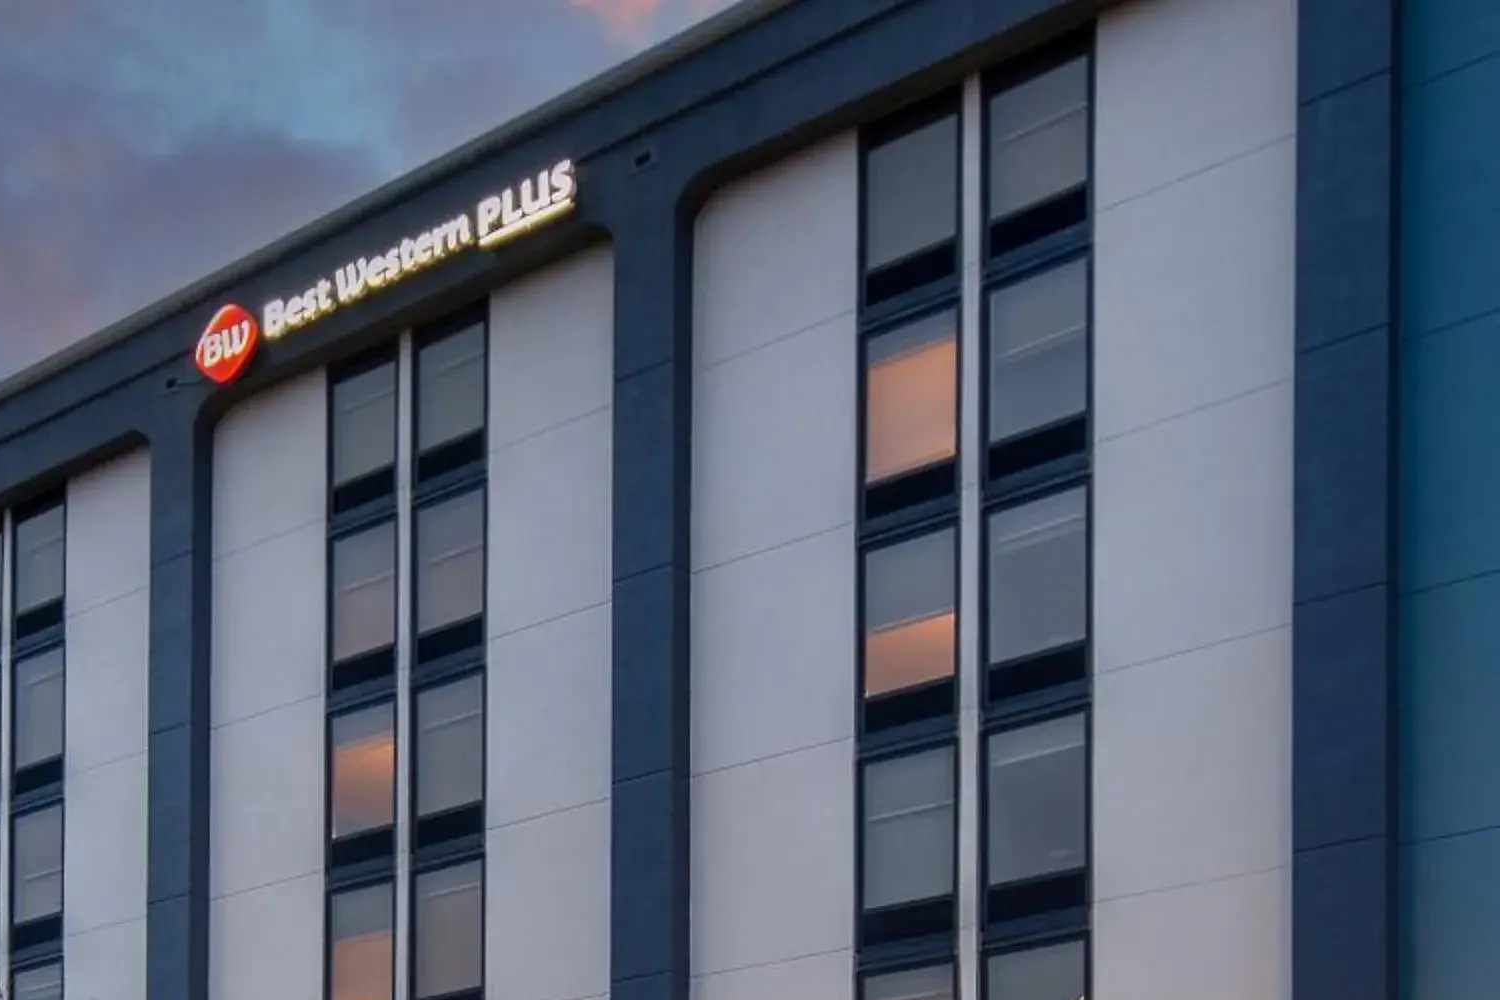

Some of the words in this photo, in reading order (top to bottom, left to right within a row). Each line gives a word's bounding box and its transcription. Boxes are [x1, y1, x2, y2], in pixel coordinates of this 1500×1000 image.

[262, 276, 334, 339] Best
[334, 212, 472, 303] Western
[476, 158, 577, 235] PLUS
[203, 318, 249, 368] BW
